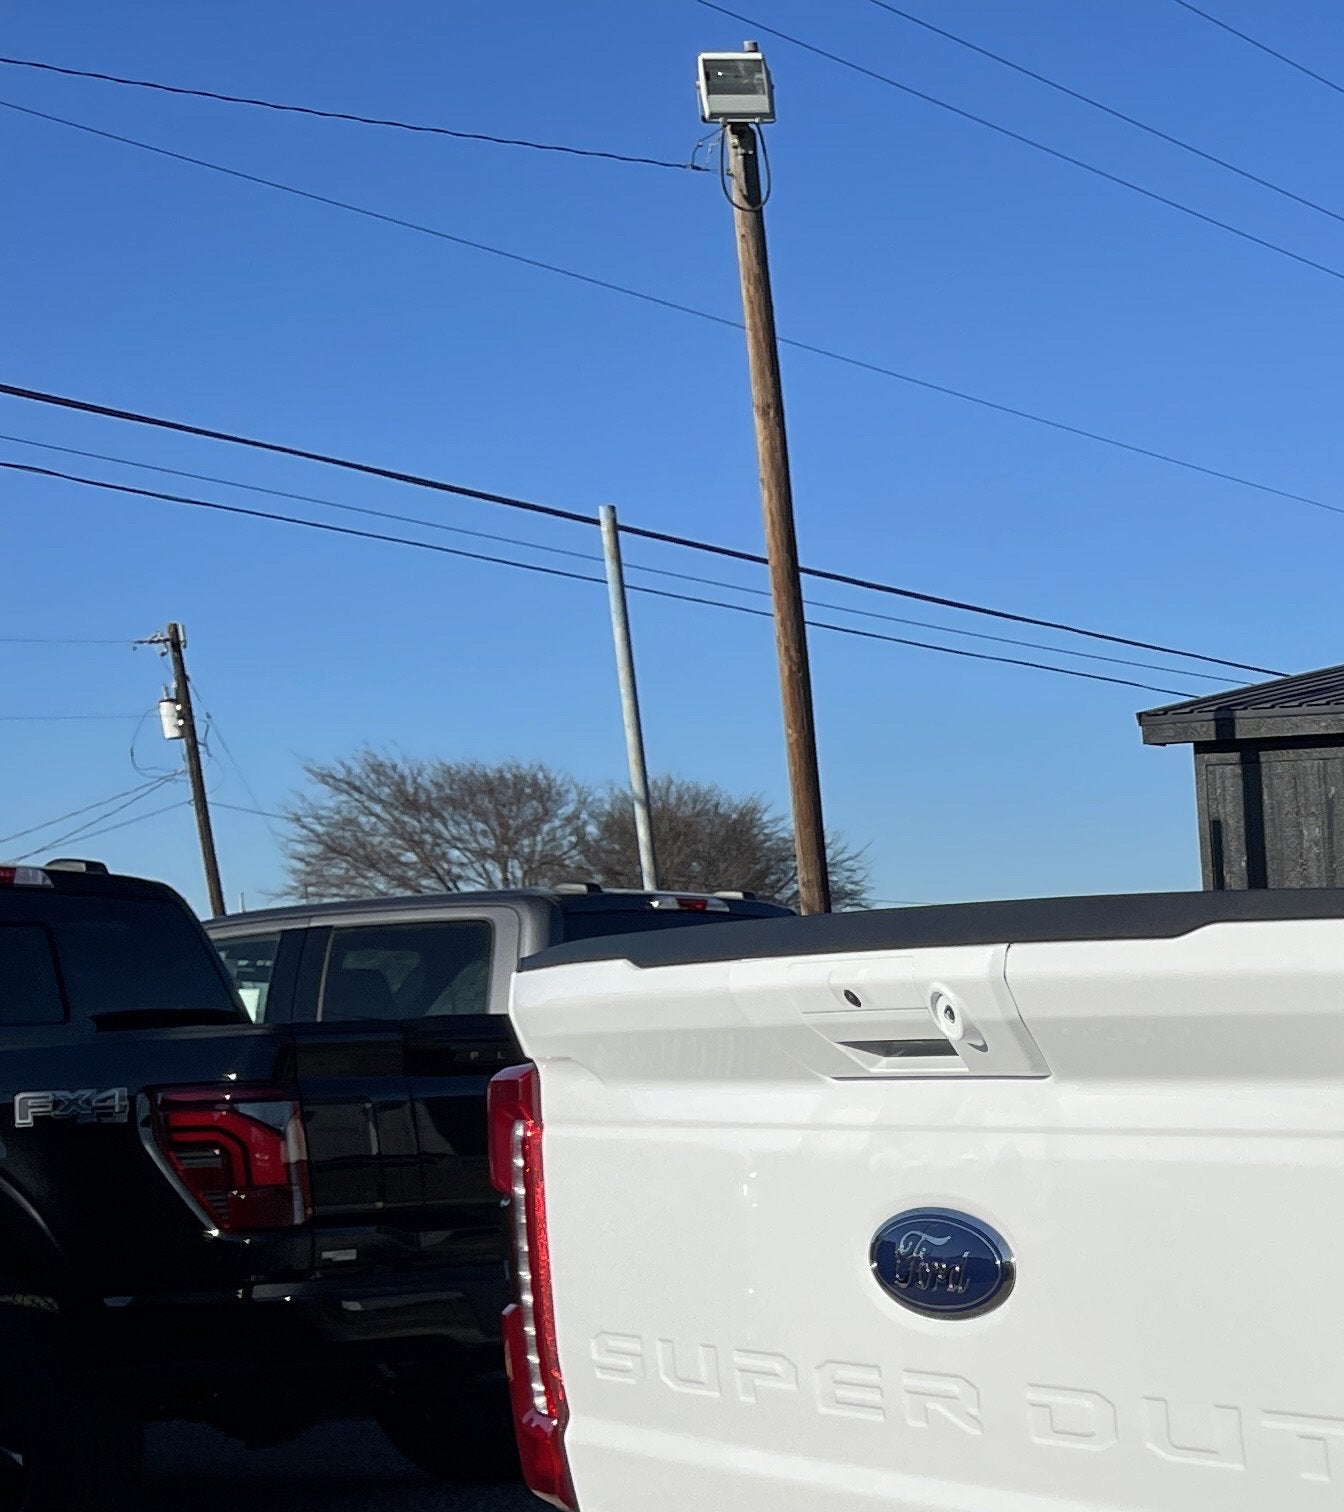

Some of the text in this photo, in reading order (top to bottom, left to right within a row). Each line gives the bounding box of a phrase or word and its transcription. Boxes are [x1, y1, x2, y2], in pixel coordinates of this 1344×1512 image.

[14, 1087, 129, 1128] FX4
[894, 1230, 972, 1293] Ford
[590, 1329, 983, 1436] SUPER
